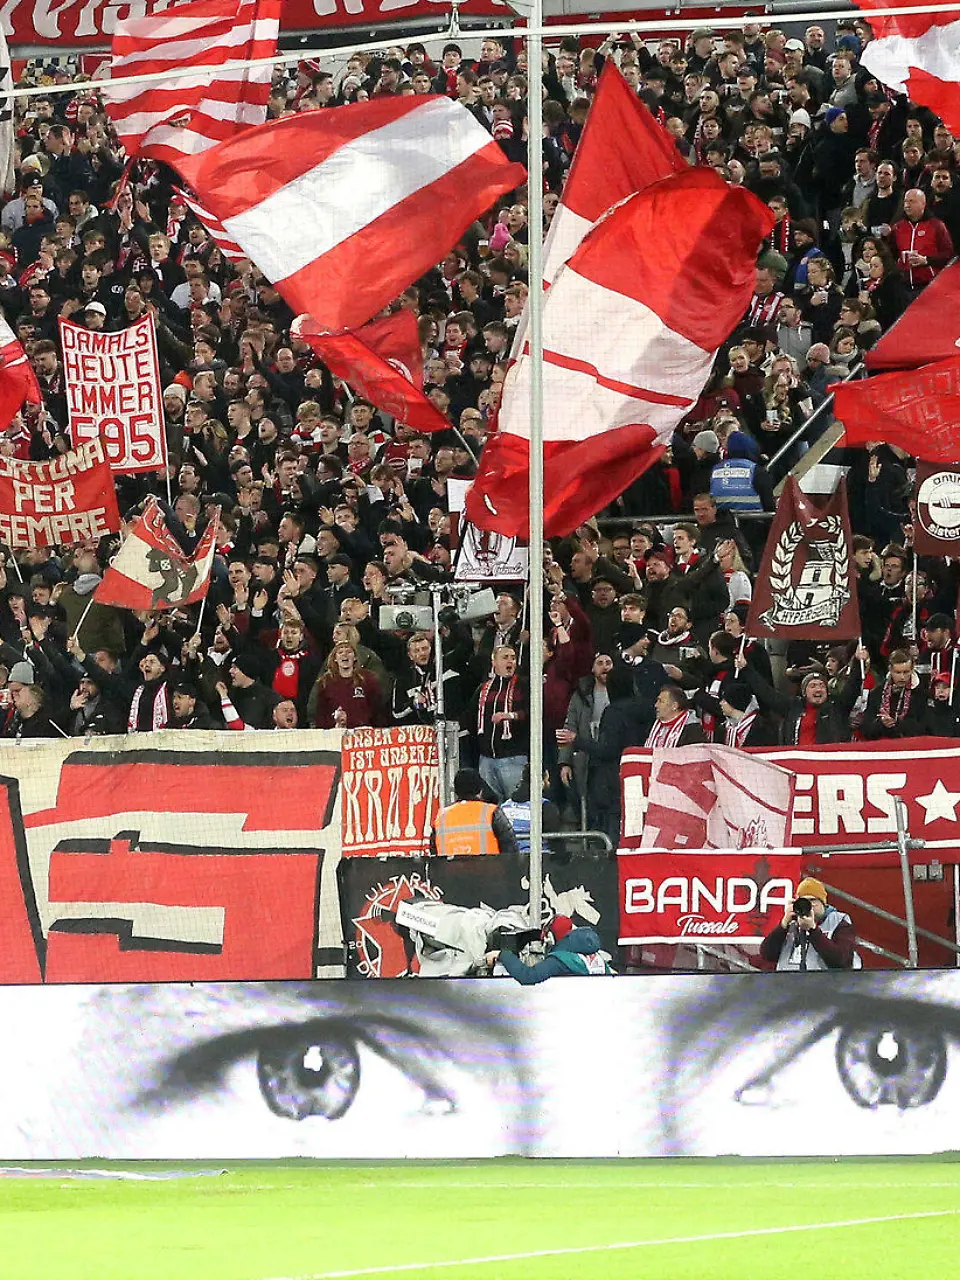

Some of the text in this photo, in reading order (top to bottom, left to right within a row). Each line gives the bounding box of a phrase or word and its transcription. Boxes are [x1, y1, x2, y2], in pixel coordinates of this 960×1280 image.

[63, 324, 149, 354] DAMALS
[65, 349, 151, 382] HEUTE
[69, 381, 154, 415] IMMER
[13, 480, 76, 513] PER
[625, 877, 794, 914] BANDA
